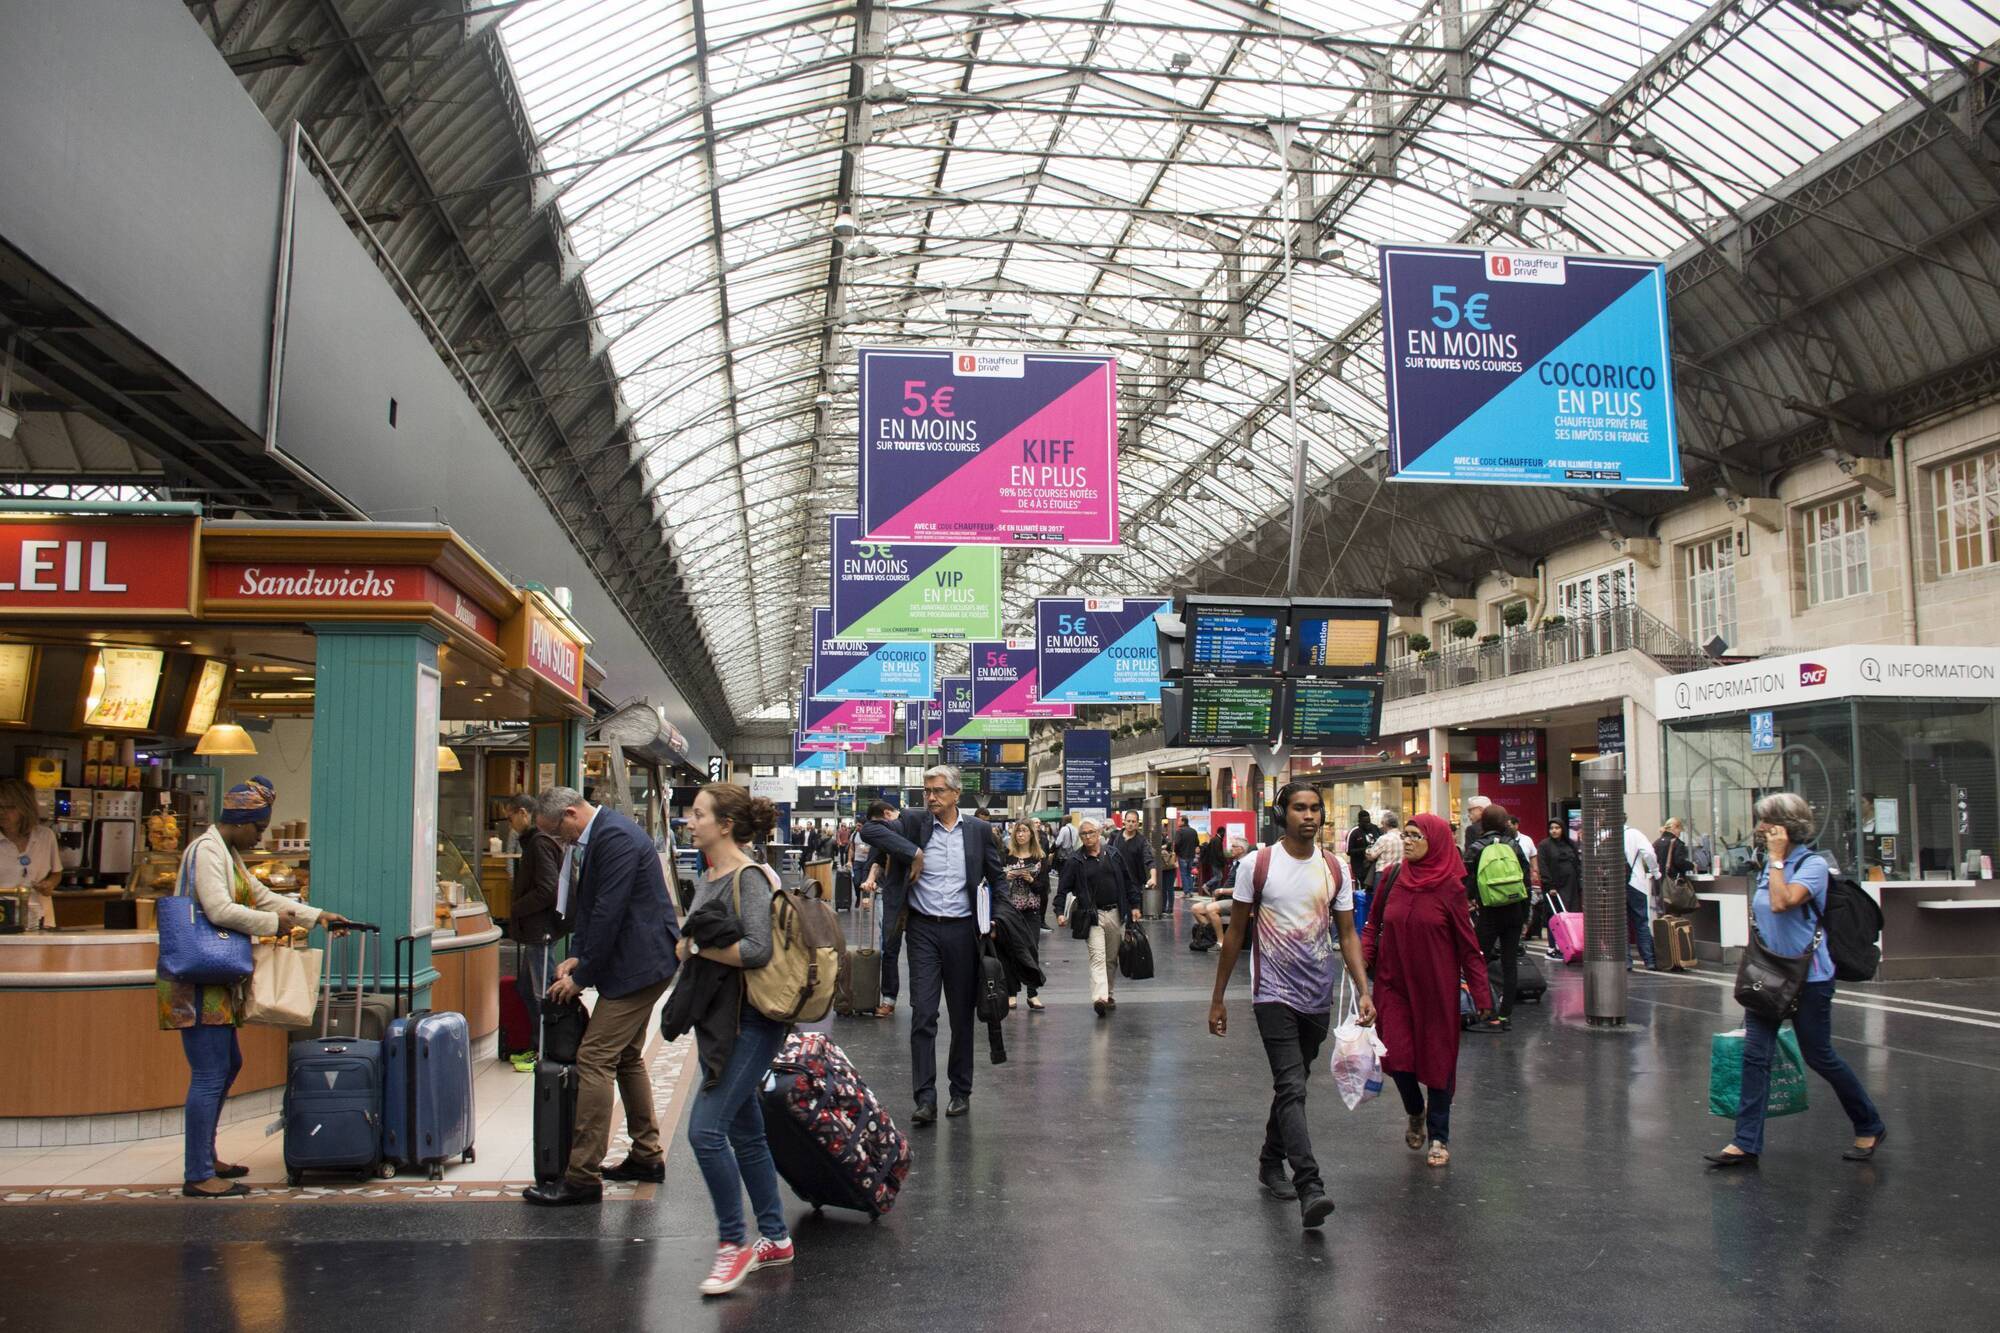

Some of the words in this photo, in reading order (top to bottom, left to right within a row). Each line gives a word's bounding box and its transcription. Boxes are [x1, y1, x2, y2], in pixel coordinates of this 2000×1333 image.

[1513, 257, 1559, 269] chauffeur
[1431, 284, 1492, 330] 5€
[1408, 330, 1436, 355] EN
[1444, 331, 1518, 359] MOINS
[978, 356, 1019, 365] chauffeur
[1405, 357, 1424, 368] SUR
[1425, 358, 1461, 370] TOUTES
[1462, 359, 1481, 371] VOS
[1482, 360, 1522, 373] COURSES
[1538, 361, 1656, 391] COCORICO
[902, 380, 955, 417] 5€
[1558, 389, 1585, 414] EN
[1592, 390, 1642, 416] PLUS
[880, 418, 904, 439] EN
[911, 419, 977, 440] MOINS
[1554, 415, 1604, 428] CHAUFFEUR
[1605, 416, 1628, 429] PRIVÉ
[1630, 419, 1648, 430] PAIE
[1554, 428, 1570, 440] SES
[1571, 428, 1603, 441] IMPÔTS
[1604, 431, 1616, 442] EN
[1618, 432, 1649, 443] FRANCE
[876, 440, 893, 450] SUR
[894, 441, 926, 451] TOUTES
[926, 442, 943, 451] VOS
[944, 442, 980, 452] COURSES
[1023, 439, 1075, 464] KIFF
[1454, 456, 1470, 465] AVEC
[1480, 457, 1497, 466] CODE
[1011, 465, 1035, 487] EN
[1041, 466, 1087, 488] PLUS
[1000, 488, 1016, 497] 98%
[1018, 488, 1032, 498] DES
[1034, 488, 1068, 498] COURSES
[1069, 488, 1098, 499] NOTÉES
[1018, 499, 1029, 508] DE
[1030, 499, 1034, 508] 4
[1043, 500, 1048, 508] 5
[1016, 524, 1038, 532] ILLIMITÉ
[0, 540, 128, 592] EIL
[844, 560, 861, 574] EN
[864, 559, 908, 574] MOINS
[239, 568, 395, 597] Sandwichs
[886, 574, 910, 582] COURSES
[936, 571, 964, 587] VIP
[924, 588, 941, 602] EN
[944, 588, 975, 603] PLUS
[1058, 614, 1087, 635] 5€
[822, 640, 835, 650] EN
[836, 640, 868, 650] MOINS
[1046, 636, 1060, 647] EN
[1064, 636, 1098, 648] MOINS
[1318, 622, 1328, 666] circulation
[532, 619, 551, 668] PAIN
[552, 642, 576, 686] SOLEIL
[876, 650, 926, 662] COCORICO
[986, 652, 1008, 667] 5€
[1309, 646, 1318, 666] flash
[882, 662, 894, 672] EN
[897, 662, 920, 672] PLUS
[978, 667, 988, 676] EN
[990, 667, 1018, 677] MOINS
[1116, 660, 1130, 671] EN
[1132, 660, 1158, 671] PLUS
[1887, 663, 1994, 679] INFORMATION
[1801, 670, 1826, 684] SNCF
[1694, 672, 1785, 701] INFORMATION
[956, 688, 972, 701] 5€
[856, 706, 864, 714] EN
[866, 706, 883, 714] PLUS
